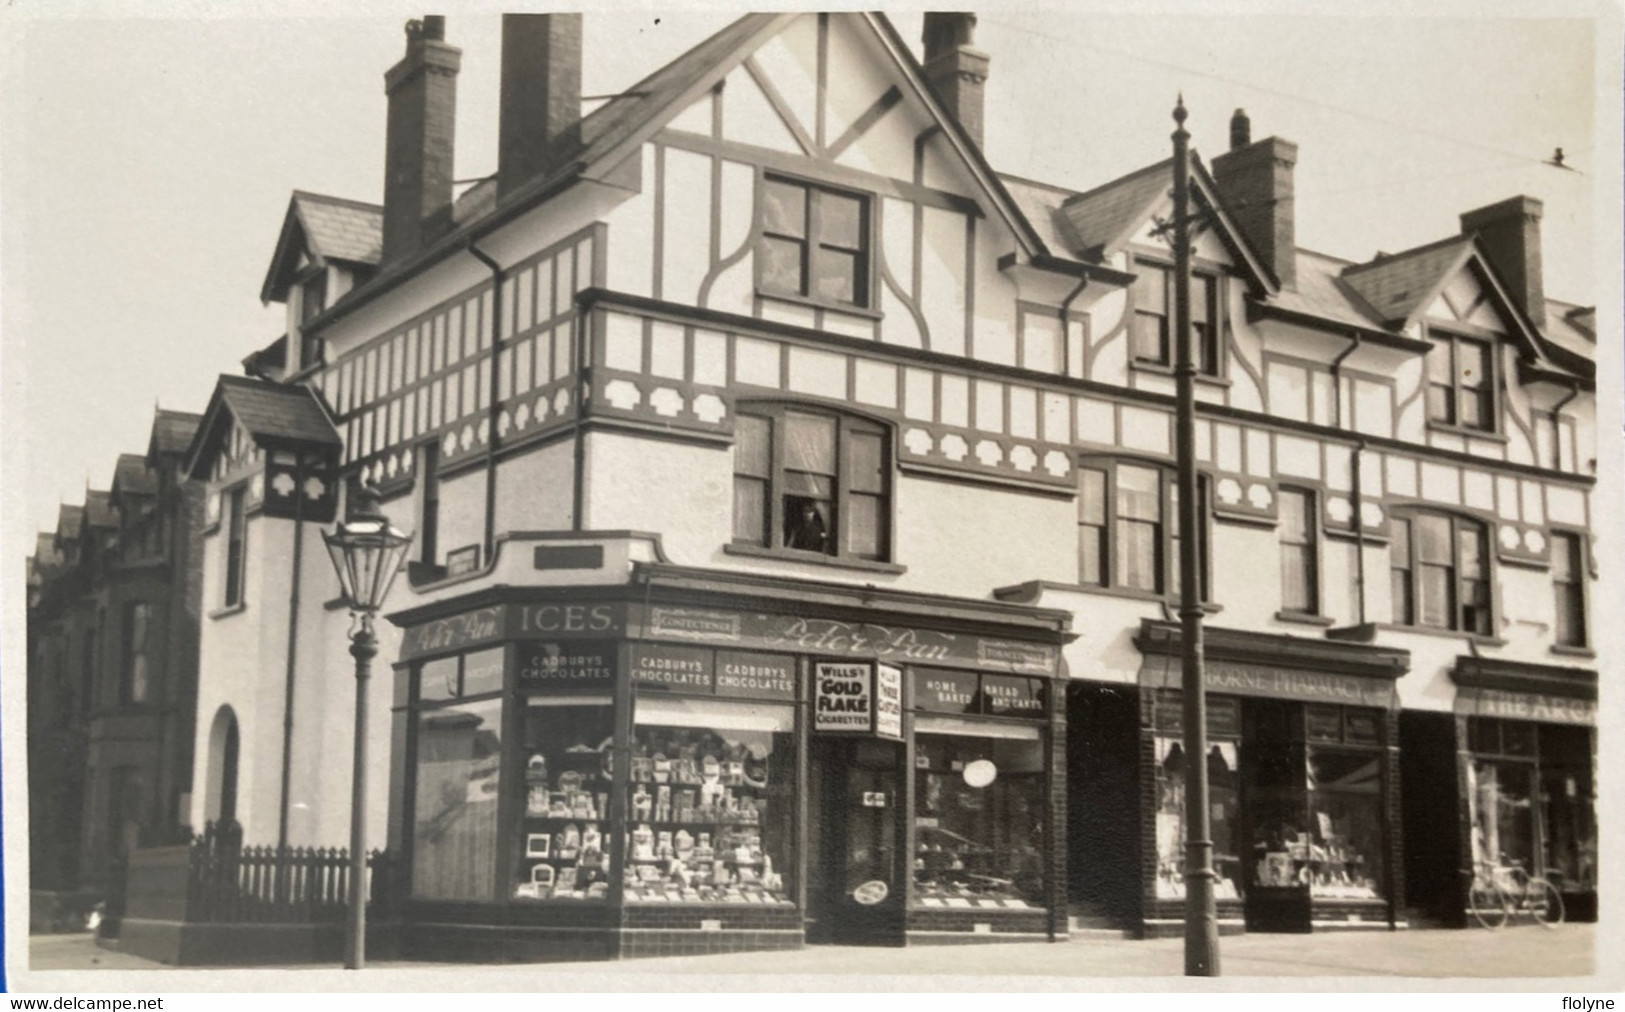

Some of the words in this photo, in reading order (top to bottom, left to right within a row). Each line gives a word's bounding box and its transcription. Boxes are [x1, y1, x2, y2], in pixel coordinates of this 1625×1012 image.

[520, 605, 619, 632] ICES.
[521, 667, 611, 679] CHOCOLATES
[631, 669, 711, 686] CHOCOLATES
[717, 675, 794, 692] CHOCOLATES
[926, 680, 957, 693] HOME
[984, 684, 1019, 697] BREAD
[937, 691, 972, 704] BAKED
[816, 712, 870, 725] CIGARETTES
